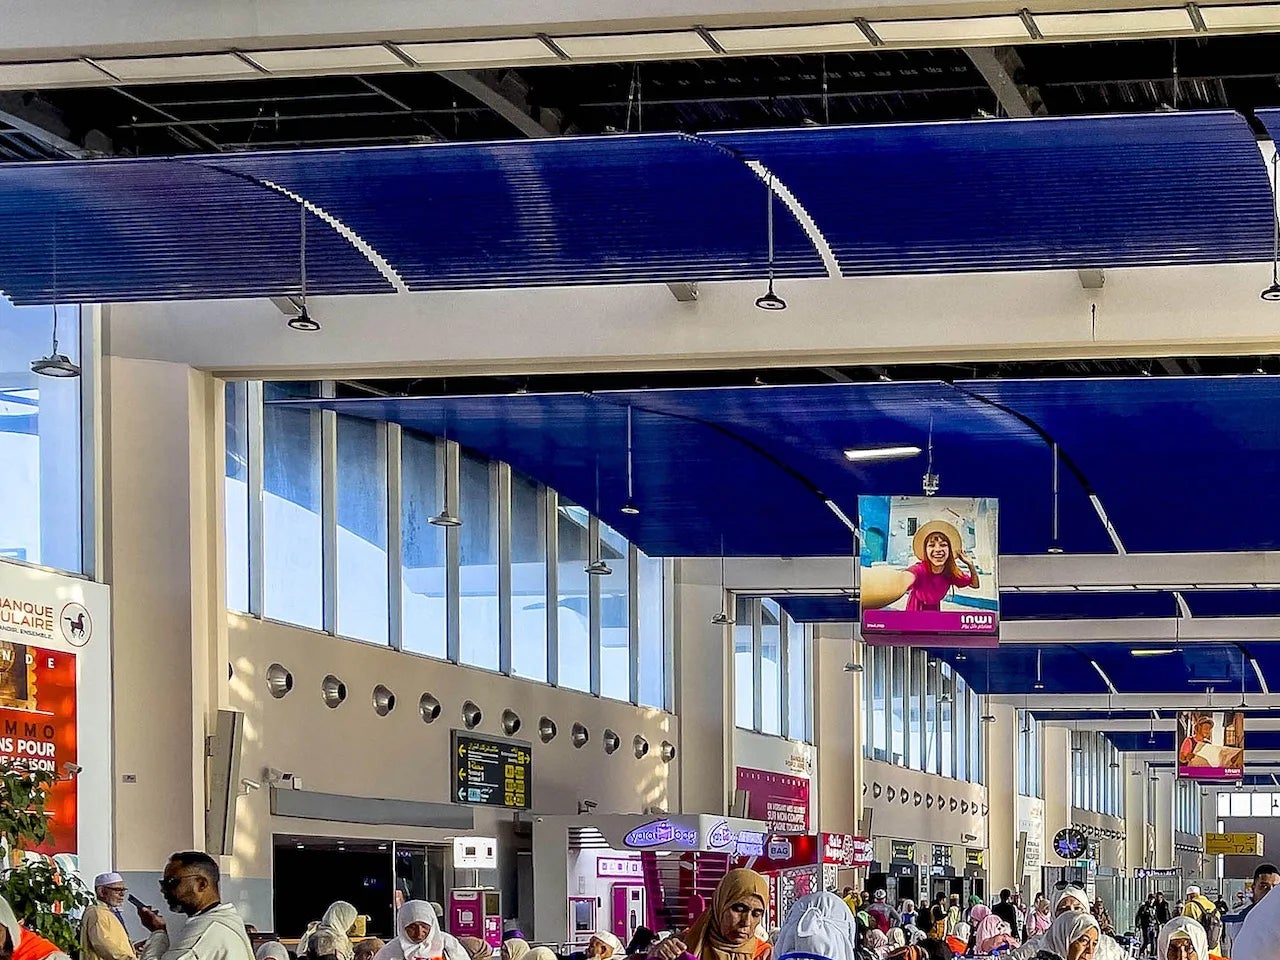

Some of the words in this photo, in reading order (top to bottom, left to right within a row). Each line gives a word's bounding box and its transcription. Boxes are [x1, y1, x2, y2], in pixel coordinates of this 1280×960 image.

[0, 599, 53, 618] ANQUE
[18, 739, 56, 757] POUR
[771, 847, 788, 855] BAG
[1233, 844, 1245, 853] T2
